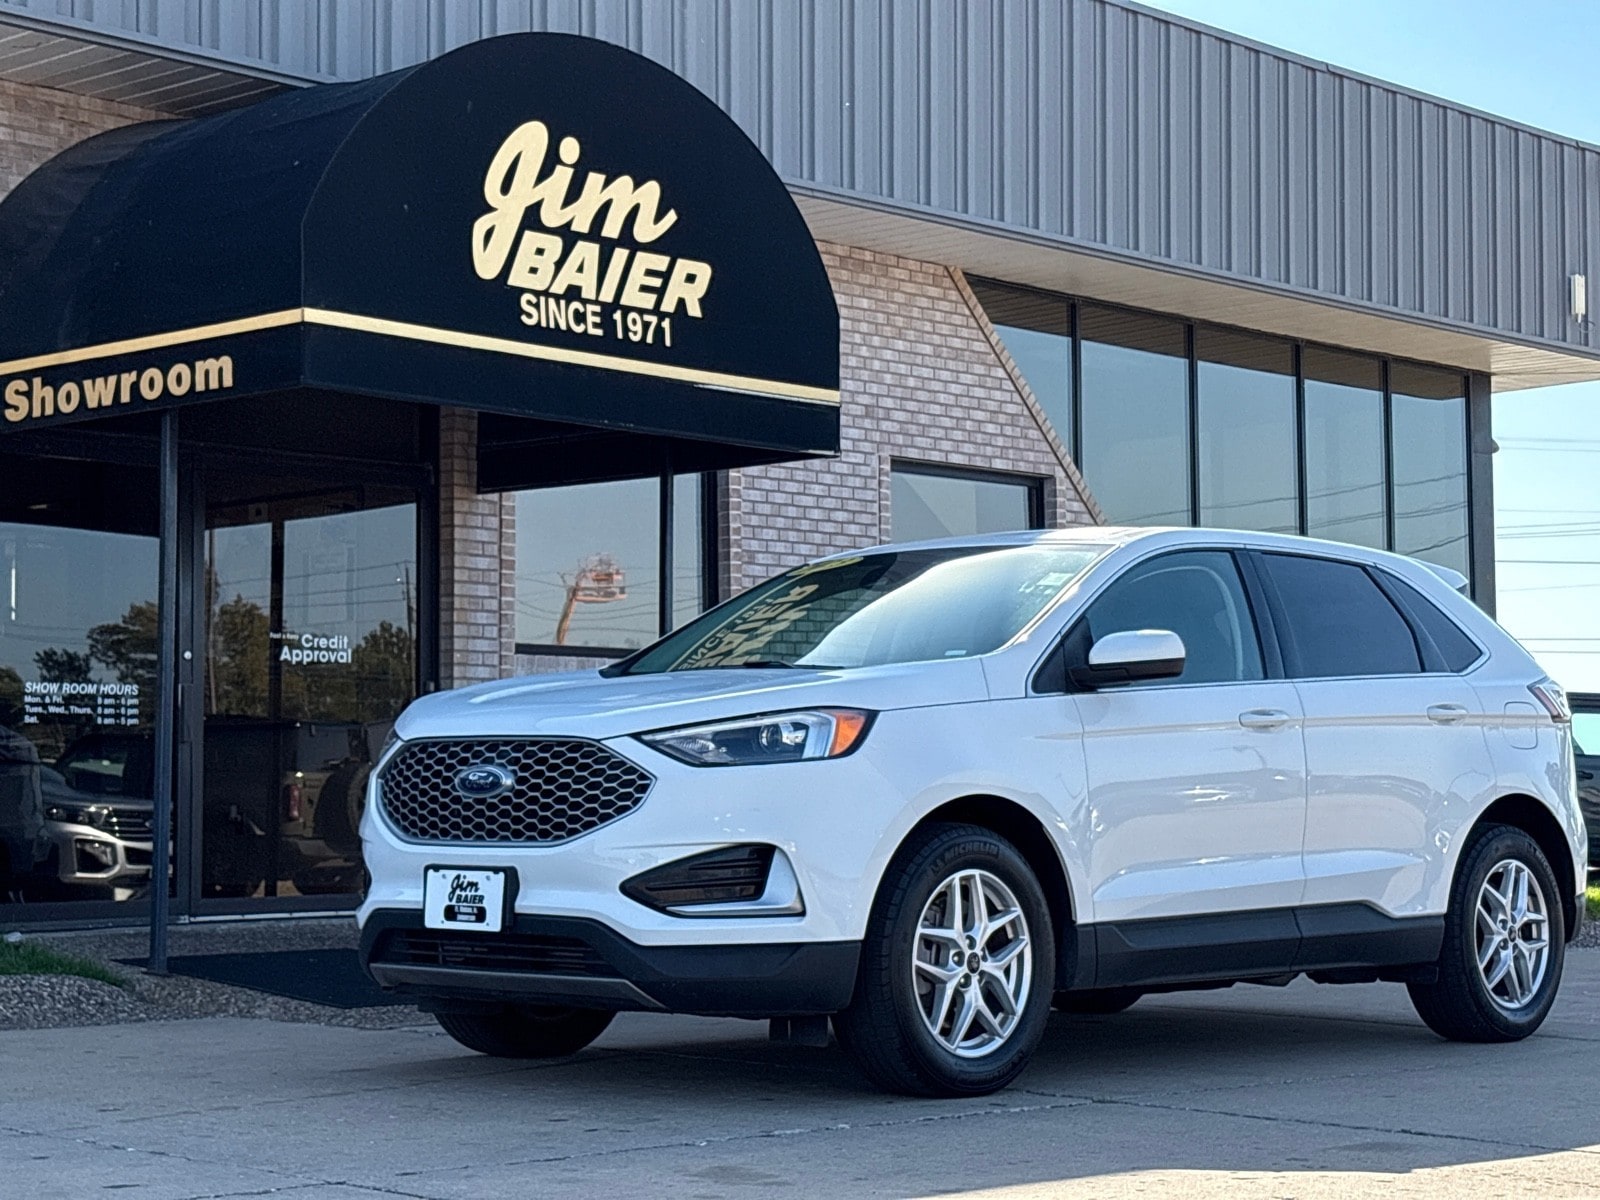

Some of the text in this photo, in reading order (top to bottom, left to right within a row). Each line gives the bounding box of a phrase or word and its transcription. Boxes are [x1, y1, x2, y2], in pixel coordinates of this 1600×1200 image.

[472, 120, 678, 280] Jim
[506, 229, 713, 319] BAIER
[519, 293, 672, 348] SINCE 1971
[4, 355, 233, 422] Showroom
[280, 645, 352, 665] Approval
[301, 633, 349, 649] Credit
[24, 681, 139, 696] SHOW ROOM HOURS
[455, 893, 485, 905] BAIER
